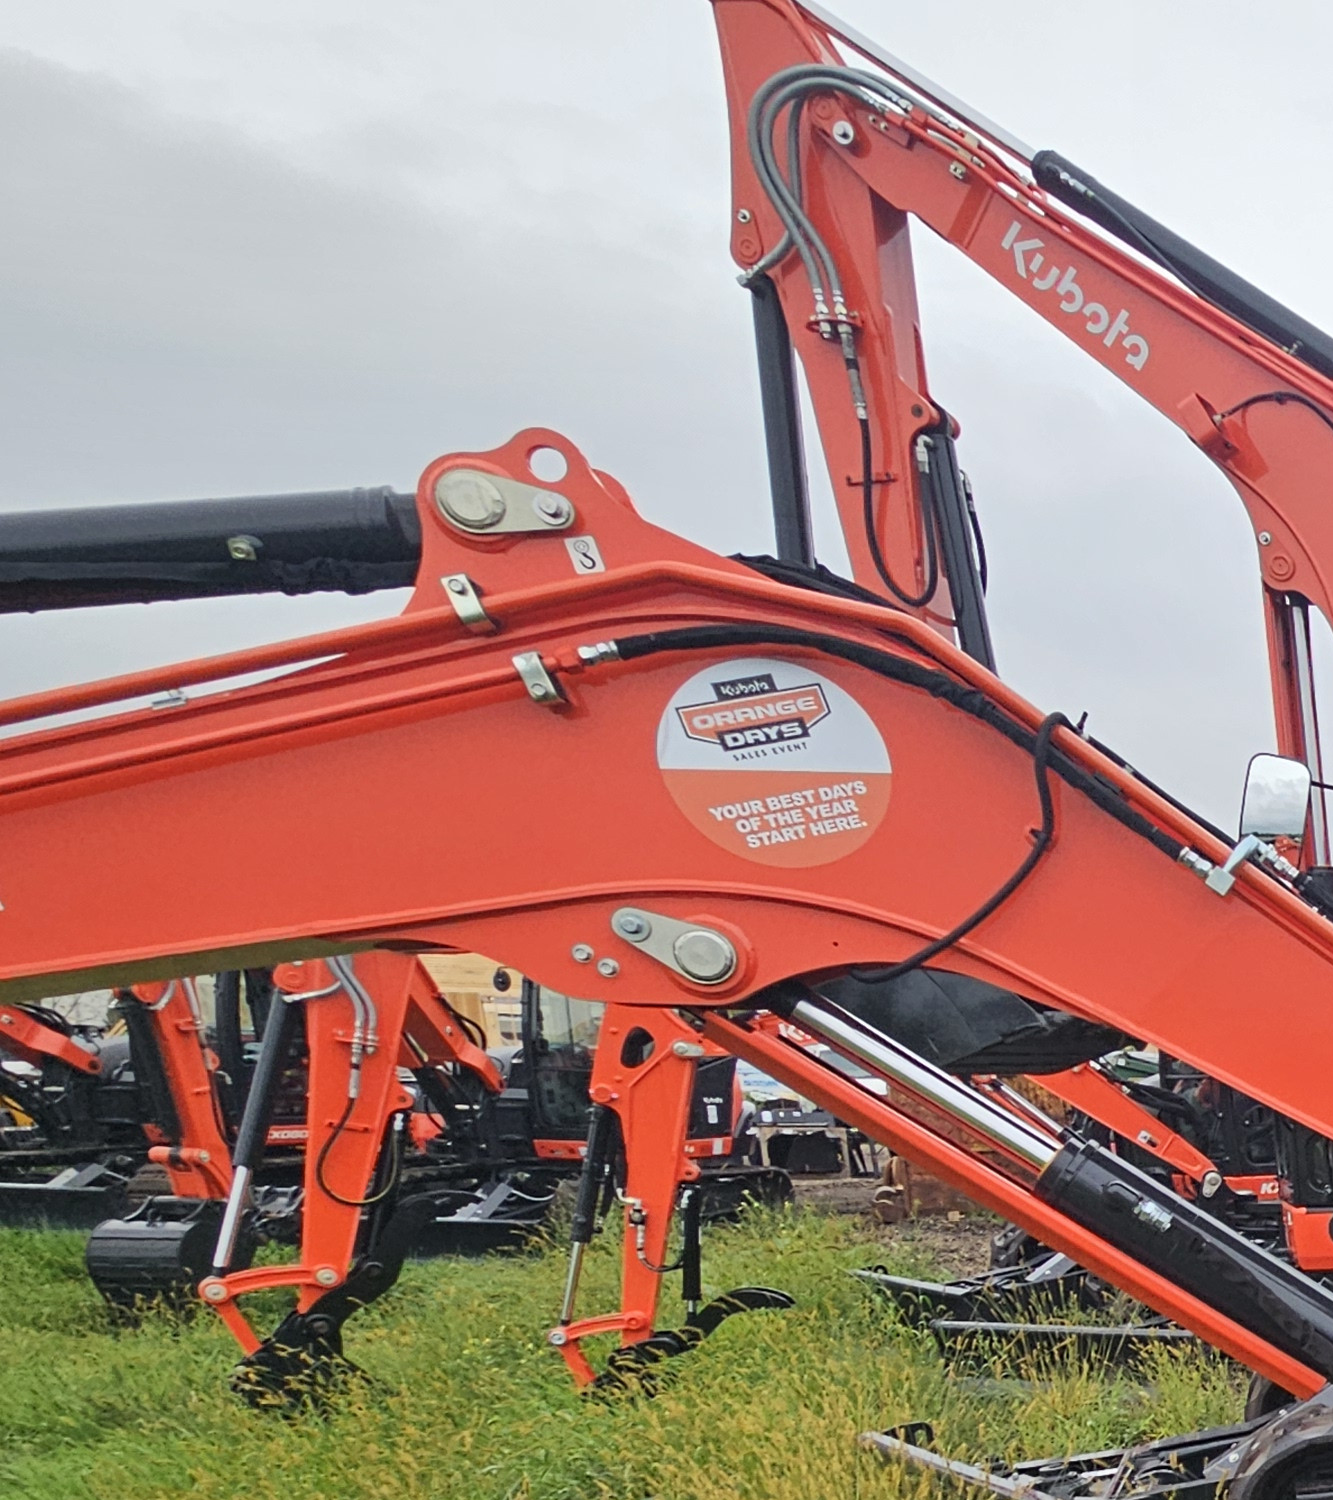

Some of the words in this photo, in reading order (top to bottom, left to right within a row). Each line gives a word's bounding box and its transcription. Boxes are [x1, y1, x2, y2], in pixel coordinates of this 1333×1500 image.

[1000, 219, 1150, 372] Kubota
[720, 680, 770, 696] Kubota
[691, 696, 819, 730] ORANGE
[723, 721, 804, 748] DAYS
[732, 750, 768, 762] SALES
[773, 742, 808, 755] EVENT
[708, 799, 767, 821] YOUR
[765, 789, 815, 811] BEST
[818, 780, 868, 801] DAYS
[735, 816, 762, 833] OF
[763, 809, 806, 828] THE
[805, 799, 860, 820] YEAR
[745, 824, 806, 848] START
[809, 814, 869, 836] HERE.
